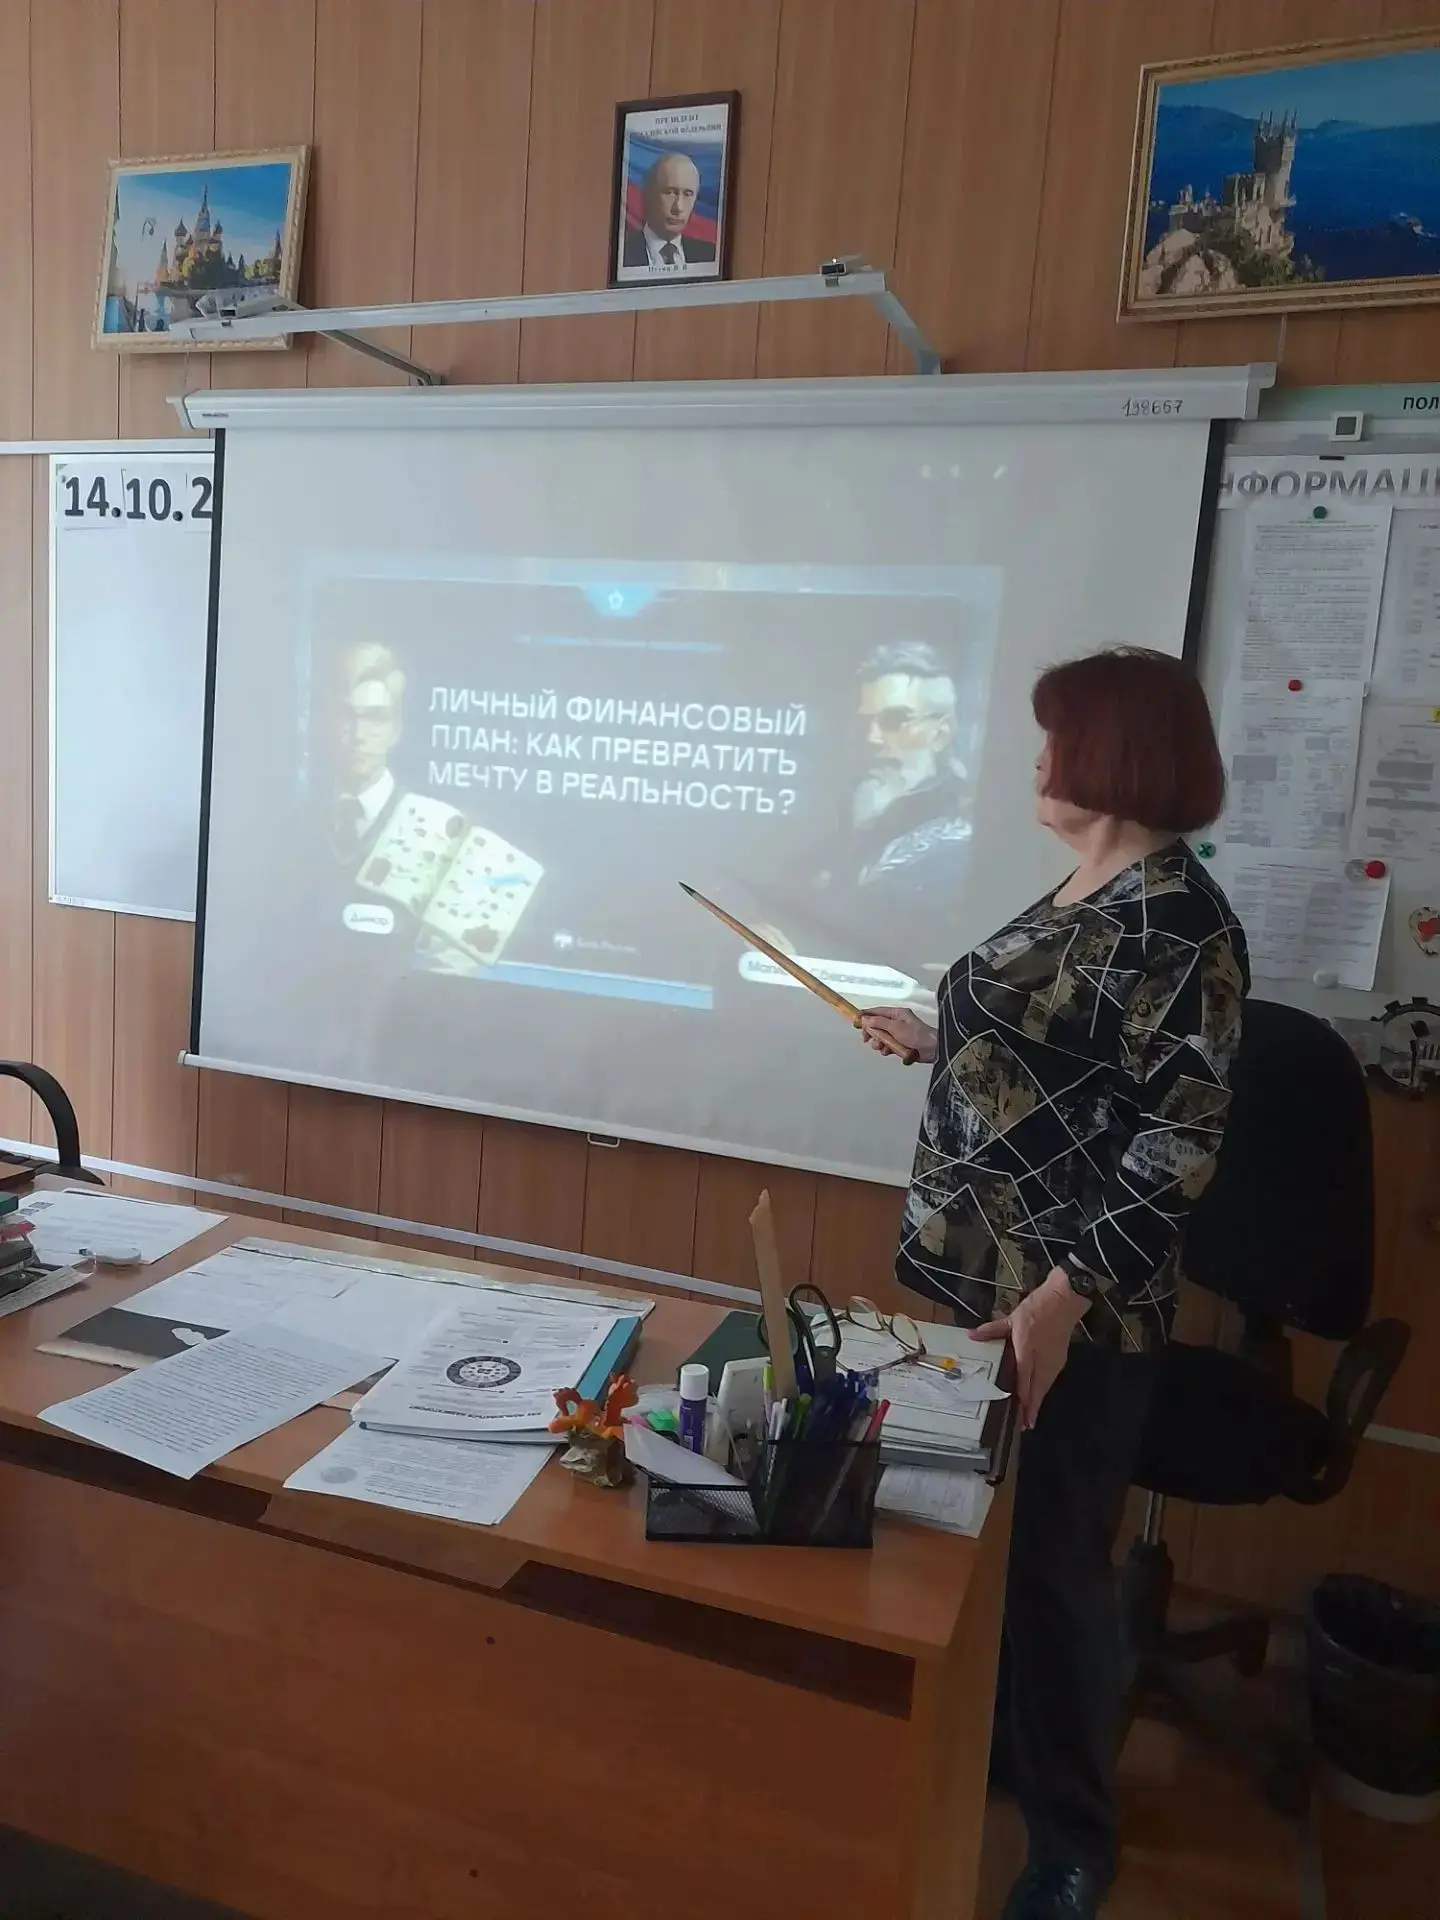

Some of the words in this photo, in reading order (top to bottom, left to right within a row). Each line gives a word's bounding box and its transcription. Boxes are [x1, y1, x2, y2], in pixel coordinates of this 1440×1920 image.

[429, 687, 557, 720] ЛИЧНЫЙ
[566, 696, 806, 736] ФИНАНСОВЫЙ
[431, 724, 518, 755] ПЛАН:
[526, 731, 583, 760] КАК
[591, 736, 797, 775] ПРЕВРАТИТЬ
[428, 760, 528, 792] МЕЧТУ
[535, 769, 553, 794] В
[562, 771, 796, 815] РЕАЛЬНОСТЬ?
